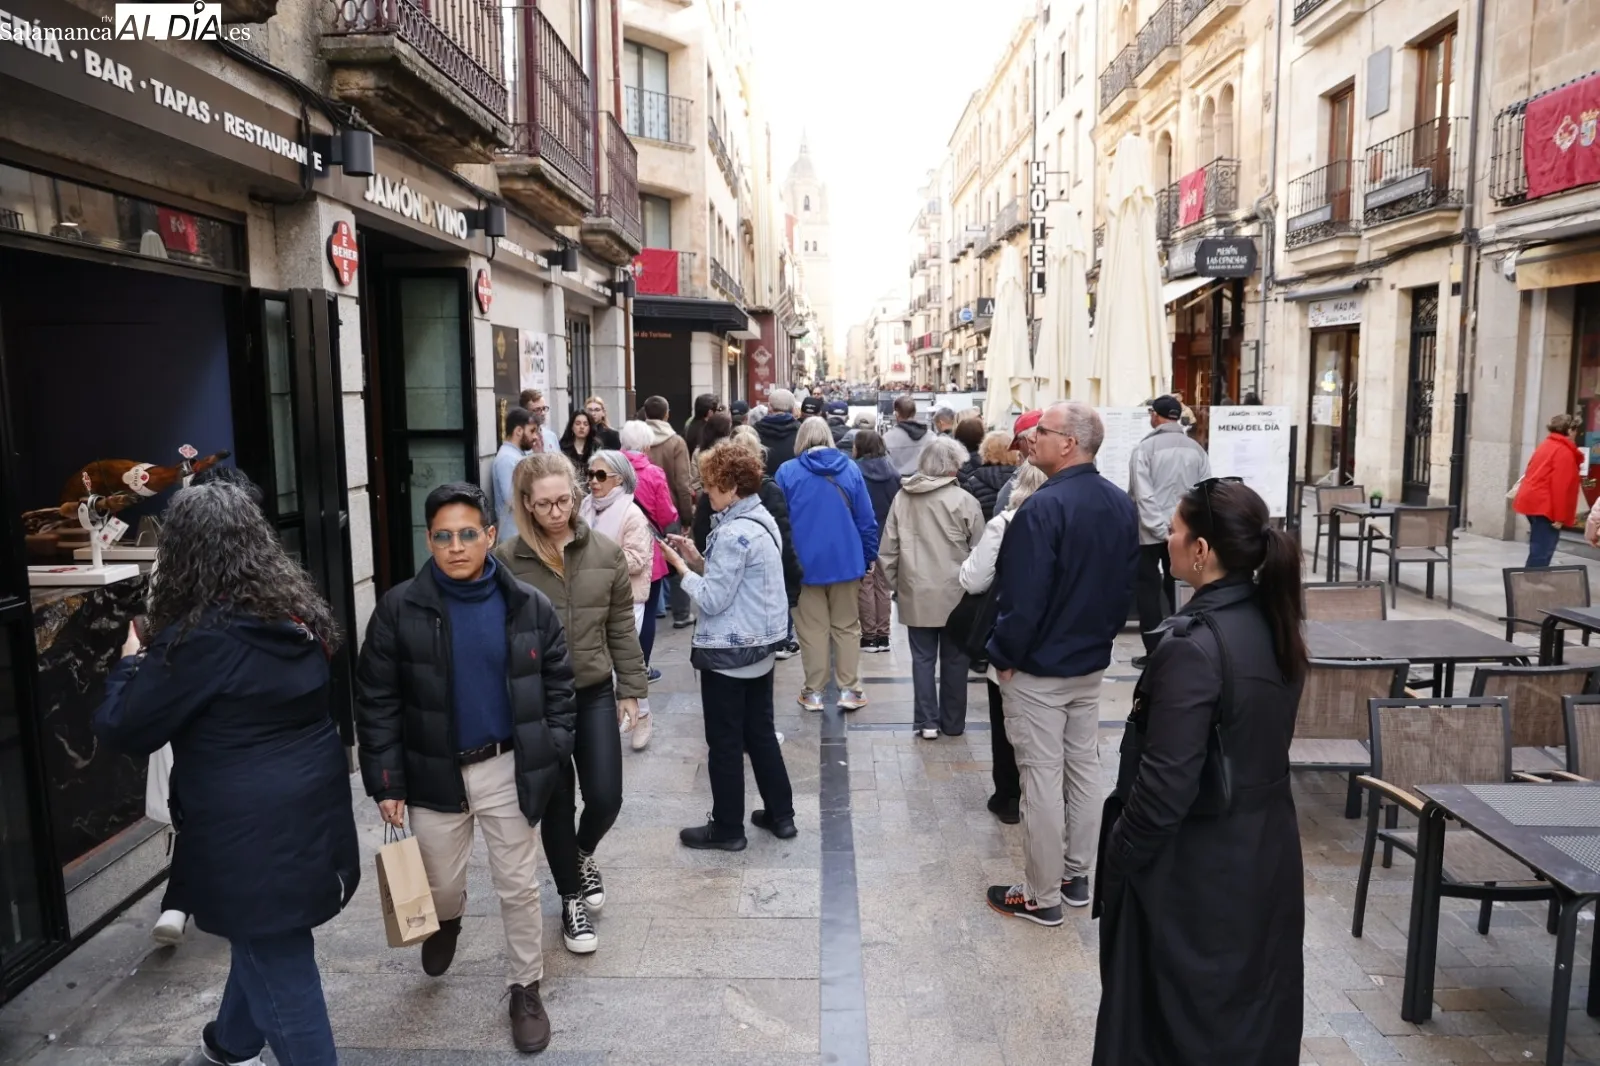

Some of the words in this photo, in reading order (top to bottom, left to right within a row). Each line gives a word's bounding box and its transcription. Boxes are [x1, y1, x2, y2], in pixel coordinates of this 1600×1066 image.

[84, 48, 135, 93] BAR
[150, 78, 211, 124] TAPAS
[223, 111, 323, 172] RESTAURANE
[363, 172, 424, 223] JAMÓN
[434, 200, 468, 240] VINO
[1031, 162, 1045, 293] HOTEL
[1218, 423, 1244, 431] MENÚ
[1264, 423, 1280, 431] DÍA
